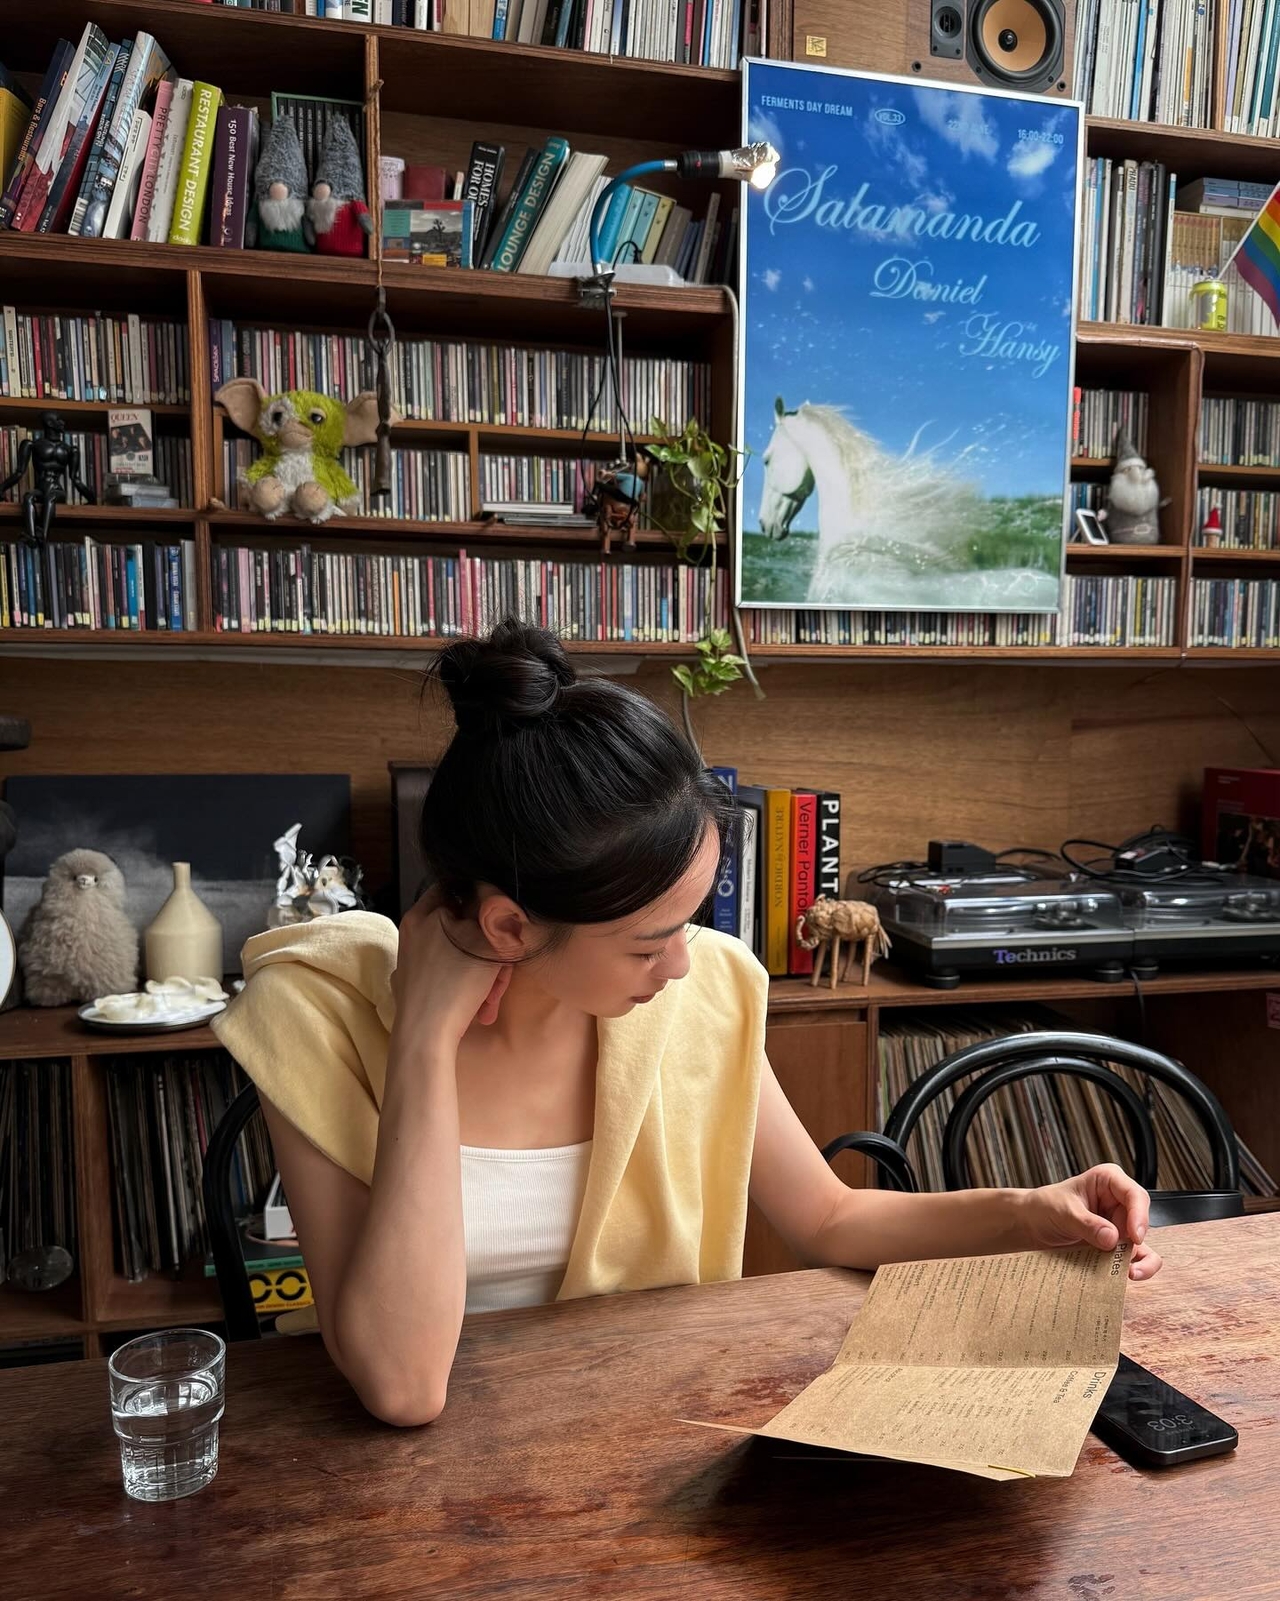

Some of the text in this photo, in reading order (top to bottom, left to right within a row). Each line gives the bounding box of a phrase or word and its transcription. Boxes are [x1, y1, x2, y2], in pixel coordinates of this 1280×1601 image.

[34, 97, 46, 112] Bars
[761, 95, 853, 117] FERMENTS DAY DREAM
[18, 120, 37, 163] Restaurants
[179, 89, 212, 231] RESTAURANT DESIGN
[225, 119, 237, 216] 150 Best New House Ideas
[468, 160, 482, 185] FOR
[478, 163, 495, 207] HOMES
[498, 152, 556, 272] LOUNGE DESIGN
[764, 165, 1041, 248] Salamanda
[870, 256, 988, 306] Daniel
[959, 312, 1060, 379] Hansy
[111, 412, 140, 422] QUEEN
[774, 806, 785, 854] NATURE
[798, 802, 812, 854] Verner
[821, 799, 840, 894] PLANT
[774, 865, 784, 908] NORDIC
[993, 948, 1077, 964] Technics
[1111, 1242, 1128, 1276] Plates
[1082, 1371, 1107, 1400] Drinks
[1147, 1414, 1193, 1432] 3:03
